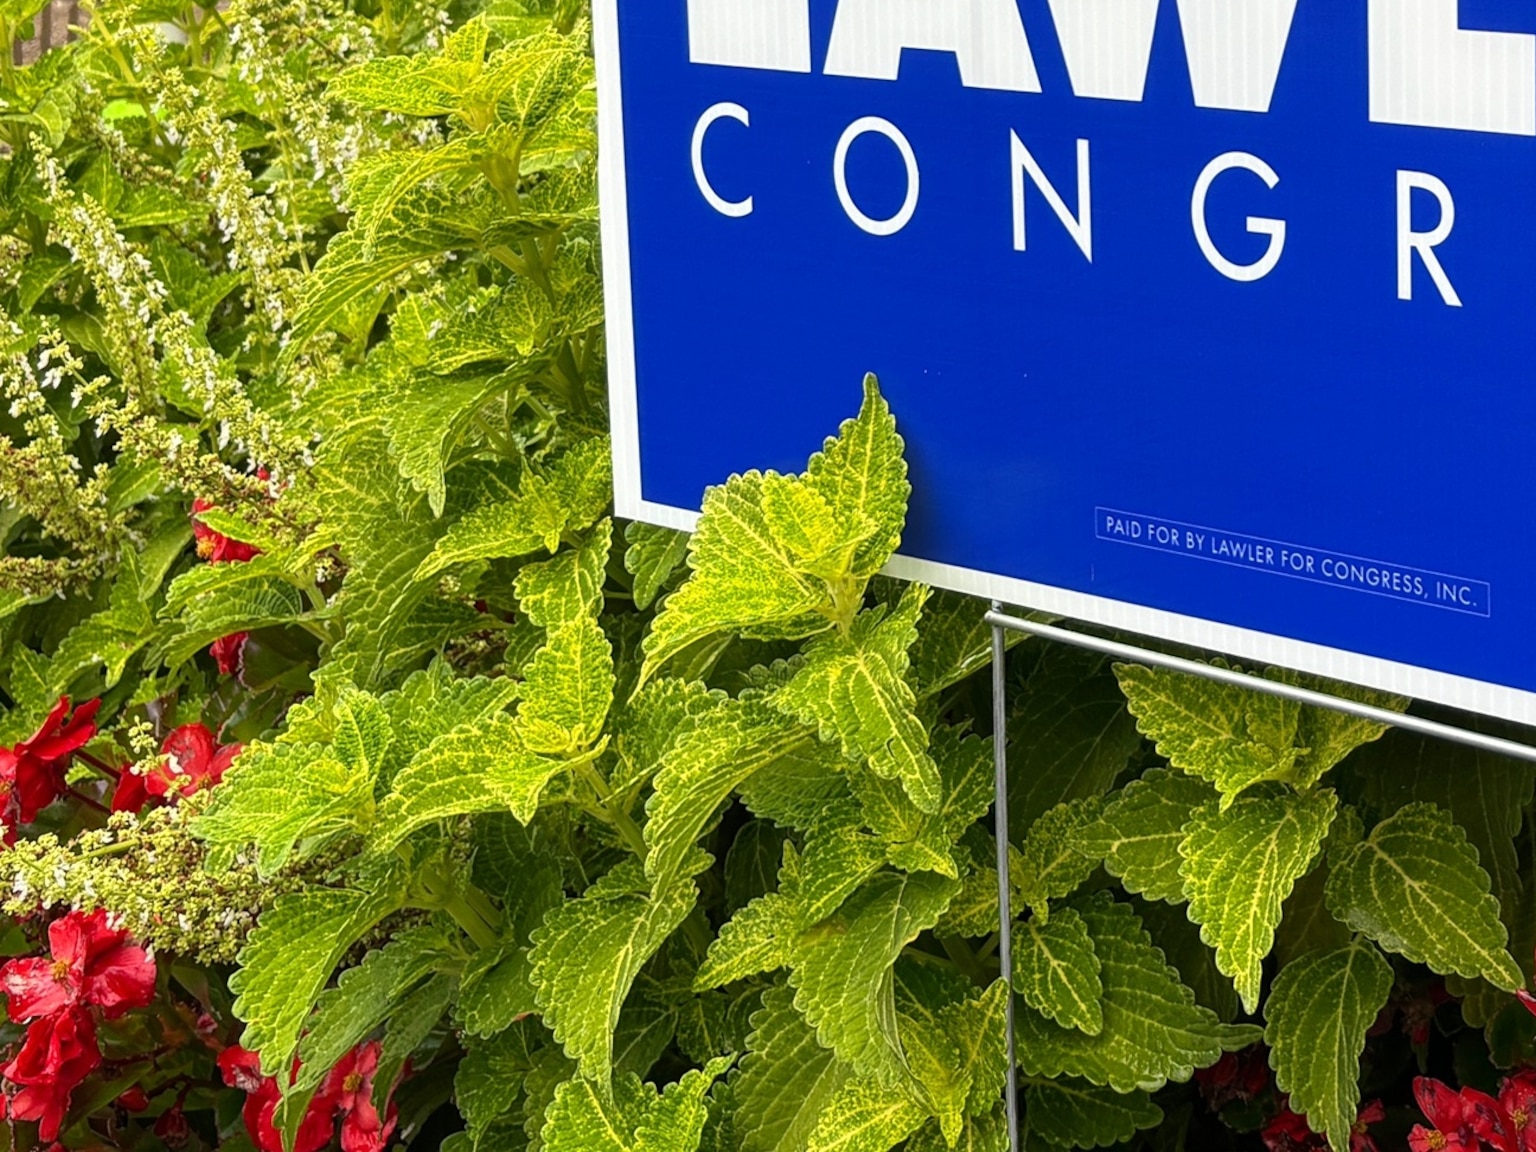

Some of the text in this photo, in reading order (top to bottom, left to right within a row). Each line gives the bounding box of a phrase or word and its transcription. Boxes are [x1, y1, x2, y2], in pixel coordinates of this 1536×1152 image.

[1106, 515, 1478, 607] PAID FOR BY LAWLER FOR CONGRESS, INC.
